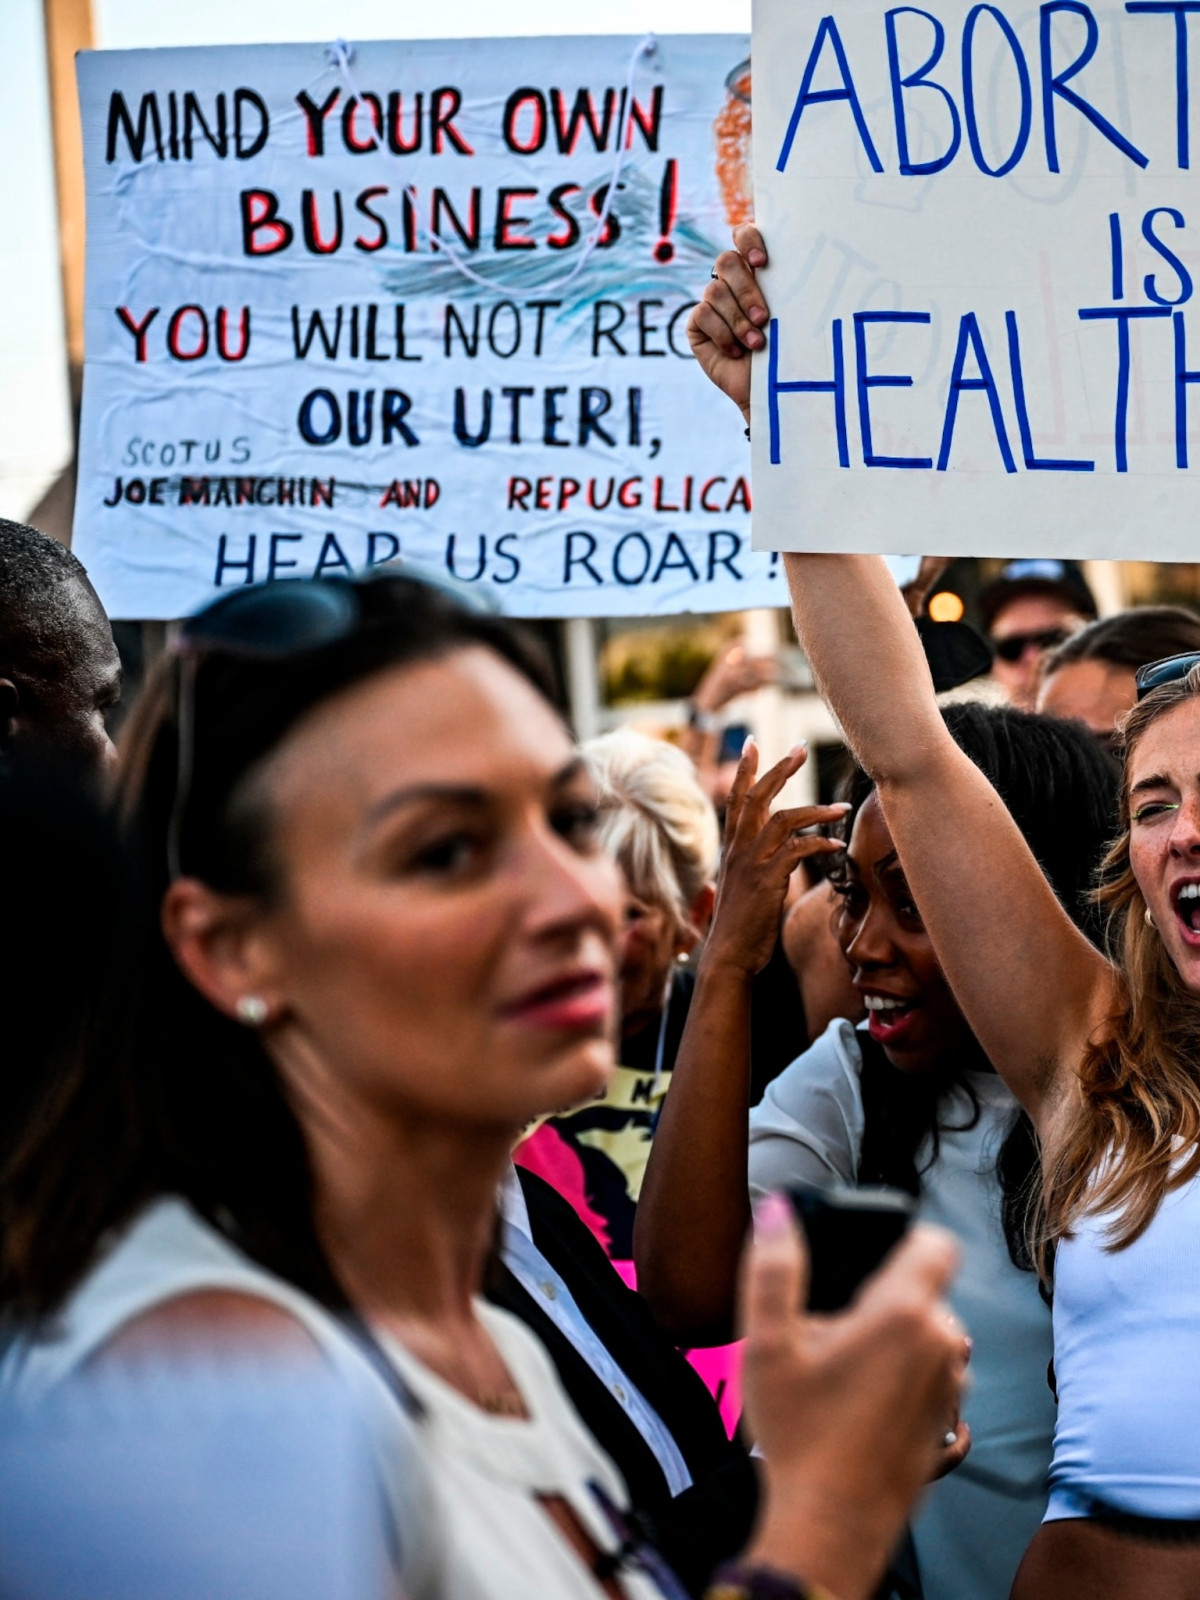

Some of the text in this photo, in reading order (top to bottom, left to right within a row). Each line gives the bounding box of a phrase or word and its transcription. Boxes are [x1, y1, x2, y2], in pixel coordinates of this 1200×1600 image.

[105, 85, 665, 163] MIND YOUR OWN
[241, 158, 677, 262] BUSINESS!
[1108, 206, 1194, 306] IS
[115, 303, 252, 363] YOU
[291, 302, 422, 362] WILL
[443, 300, 562, 360] NOT
[120, 434, 252, 468] SCOTUS
[297, 386, 662, 459] OUR UTERI,
[103, 476, 169, 508] JOE
[177, 474, 337, 508] MANCHIN
[379, 478, 441, 510] AND
[446, 533, 521, 583] US
